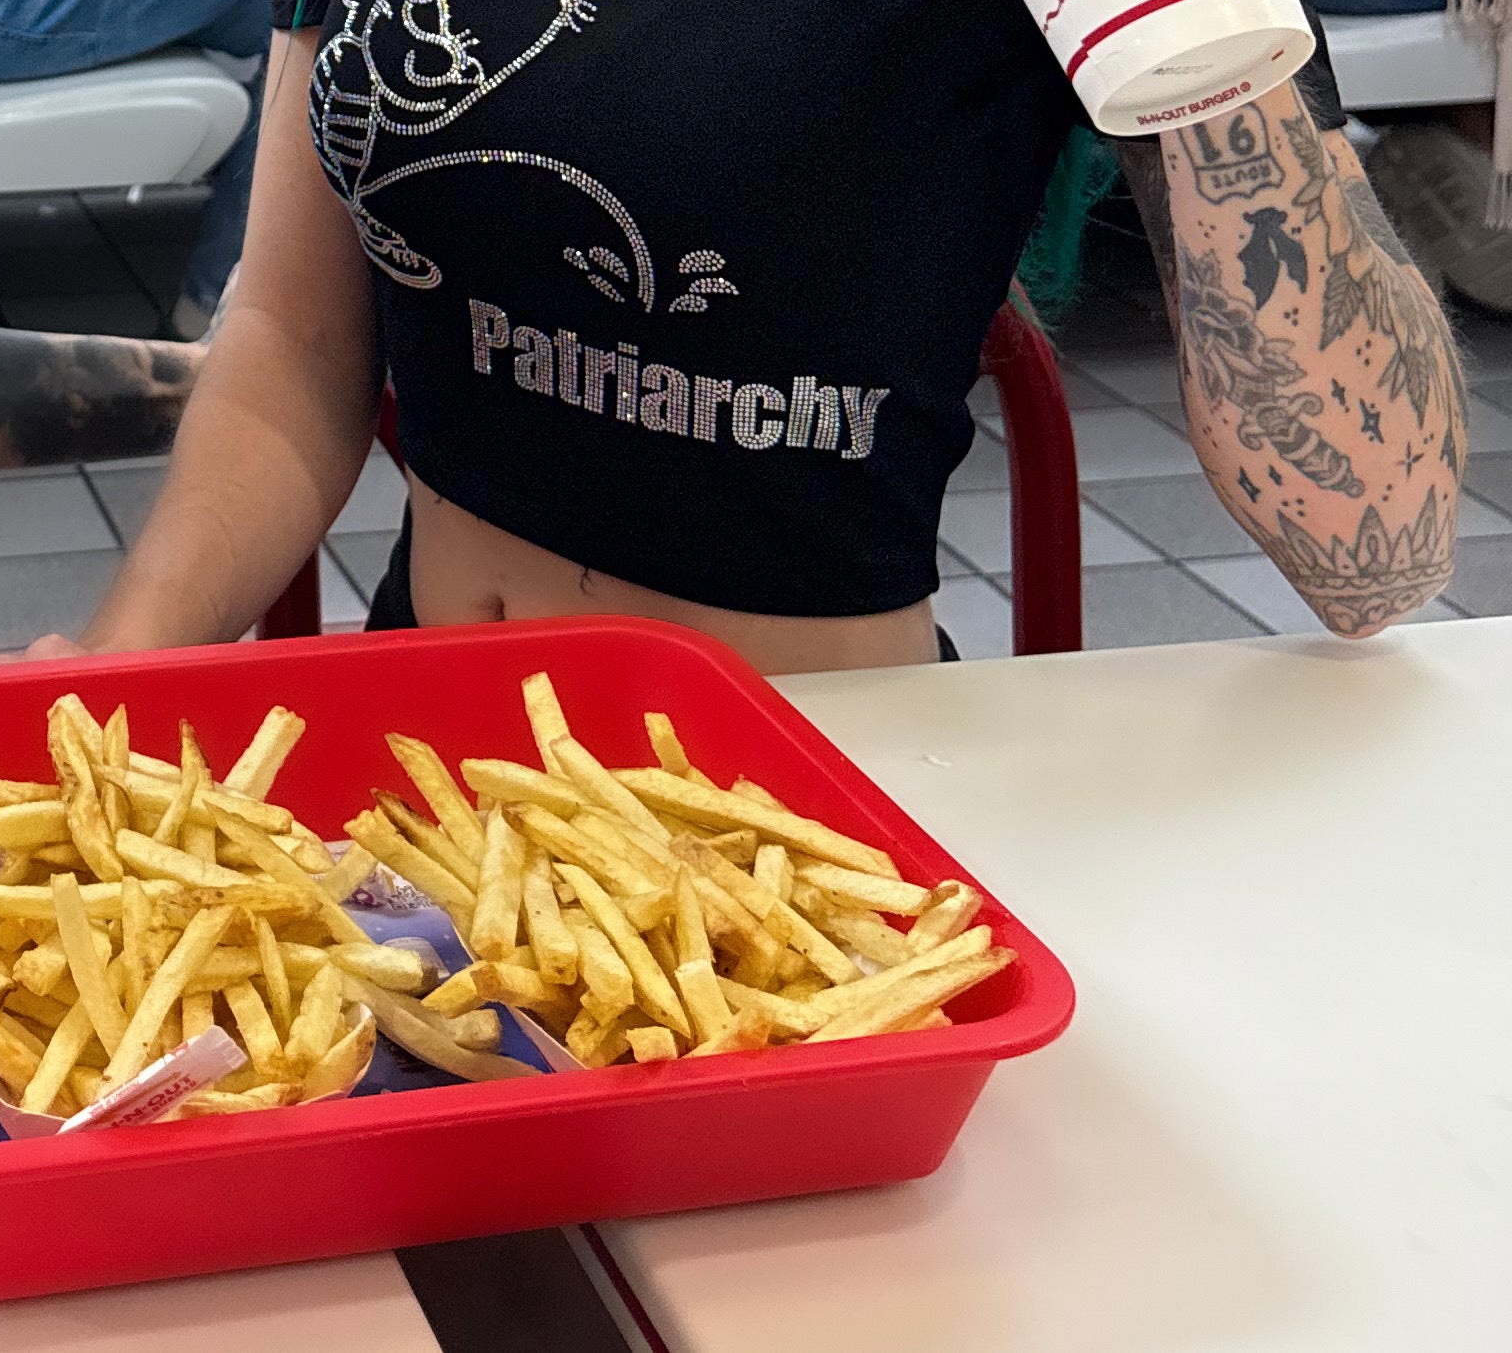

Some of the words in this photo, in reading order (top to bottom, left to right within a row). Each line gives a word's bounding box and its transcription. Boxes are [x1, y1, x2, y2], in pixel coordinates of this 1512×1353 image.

[1135, 106, 1187, 126] IN-N-OUT
[1188, 86, 1240, 114] BURGER
[468, 297, 891, 460] Patriarchy
